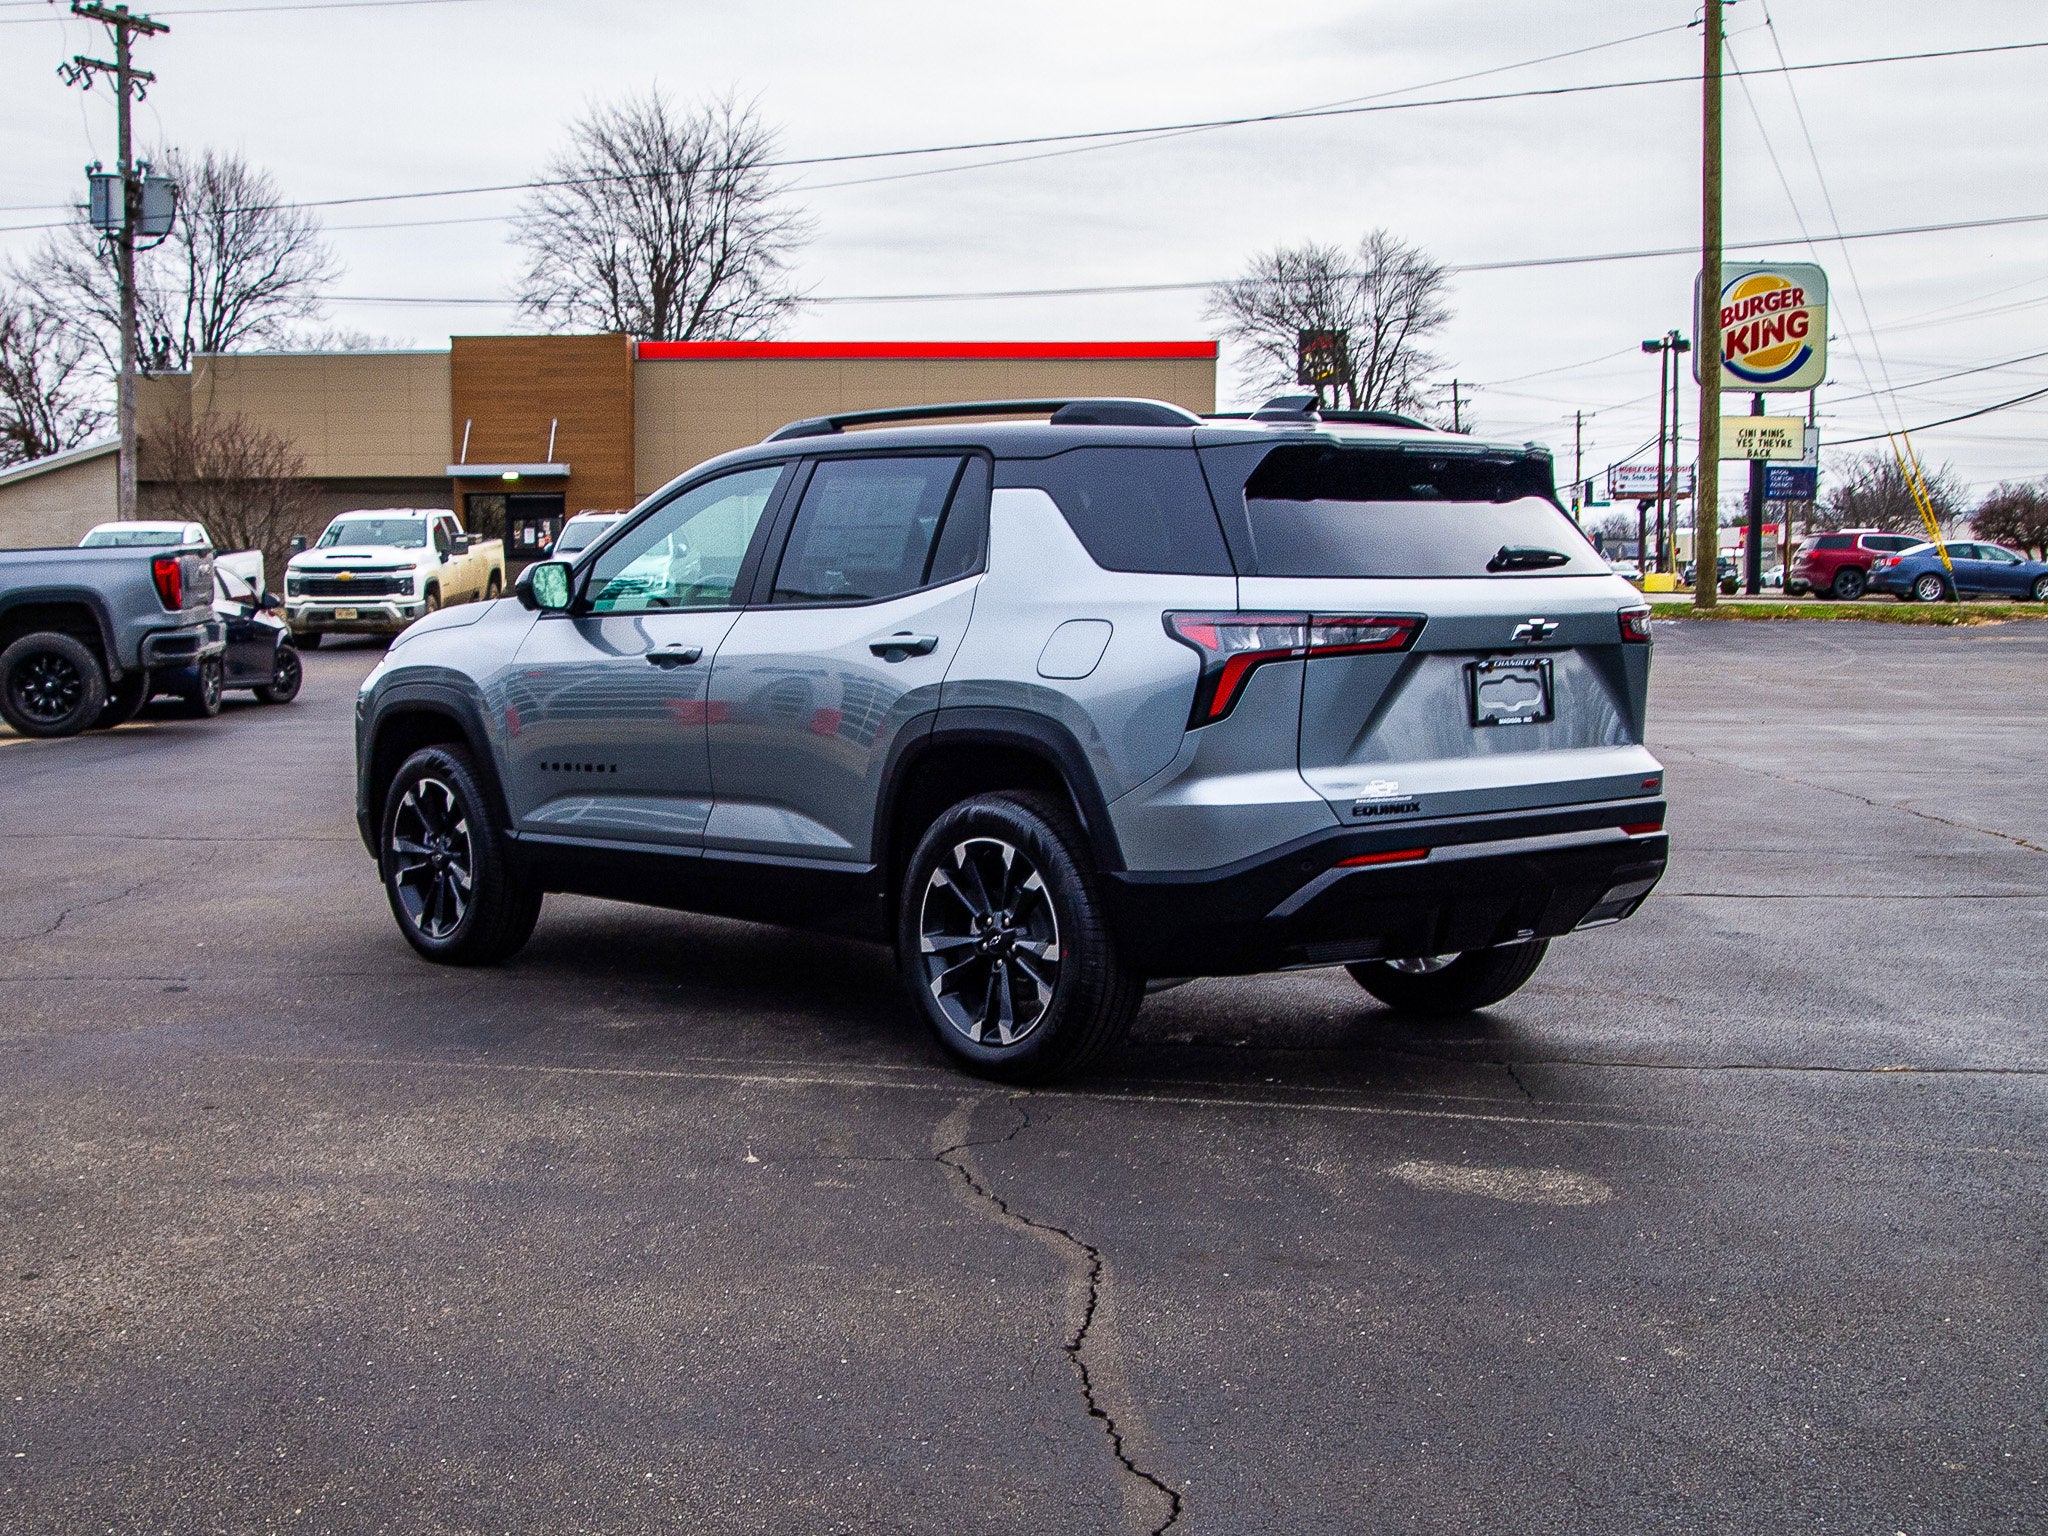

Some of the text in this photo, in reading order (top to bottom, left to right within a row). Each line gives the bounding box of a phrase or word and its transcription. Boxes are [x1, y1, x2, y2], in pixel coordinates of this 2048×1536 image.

[1720, 287, 1805, 330] BURGER
[1725, 310, 1809, 361] KING
[1738, 429, 1785, 438] CINI MINIS
[1736, 439, 1793, 448] YES THEYRE
[1746, 449, 1772, 458] BACK
[1493, 659, 1536, 668] CHANDLER
[1352, 801, 1420, 817] EQUINOX
